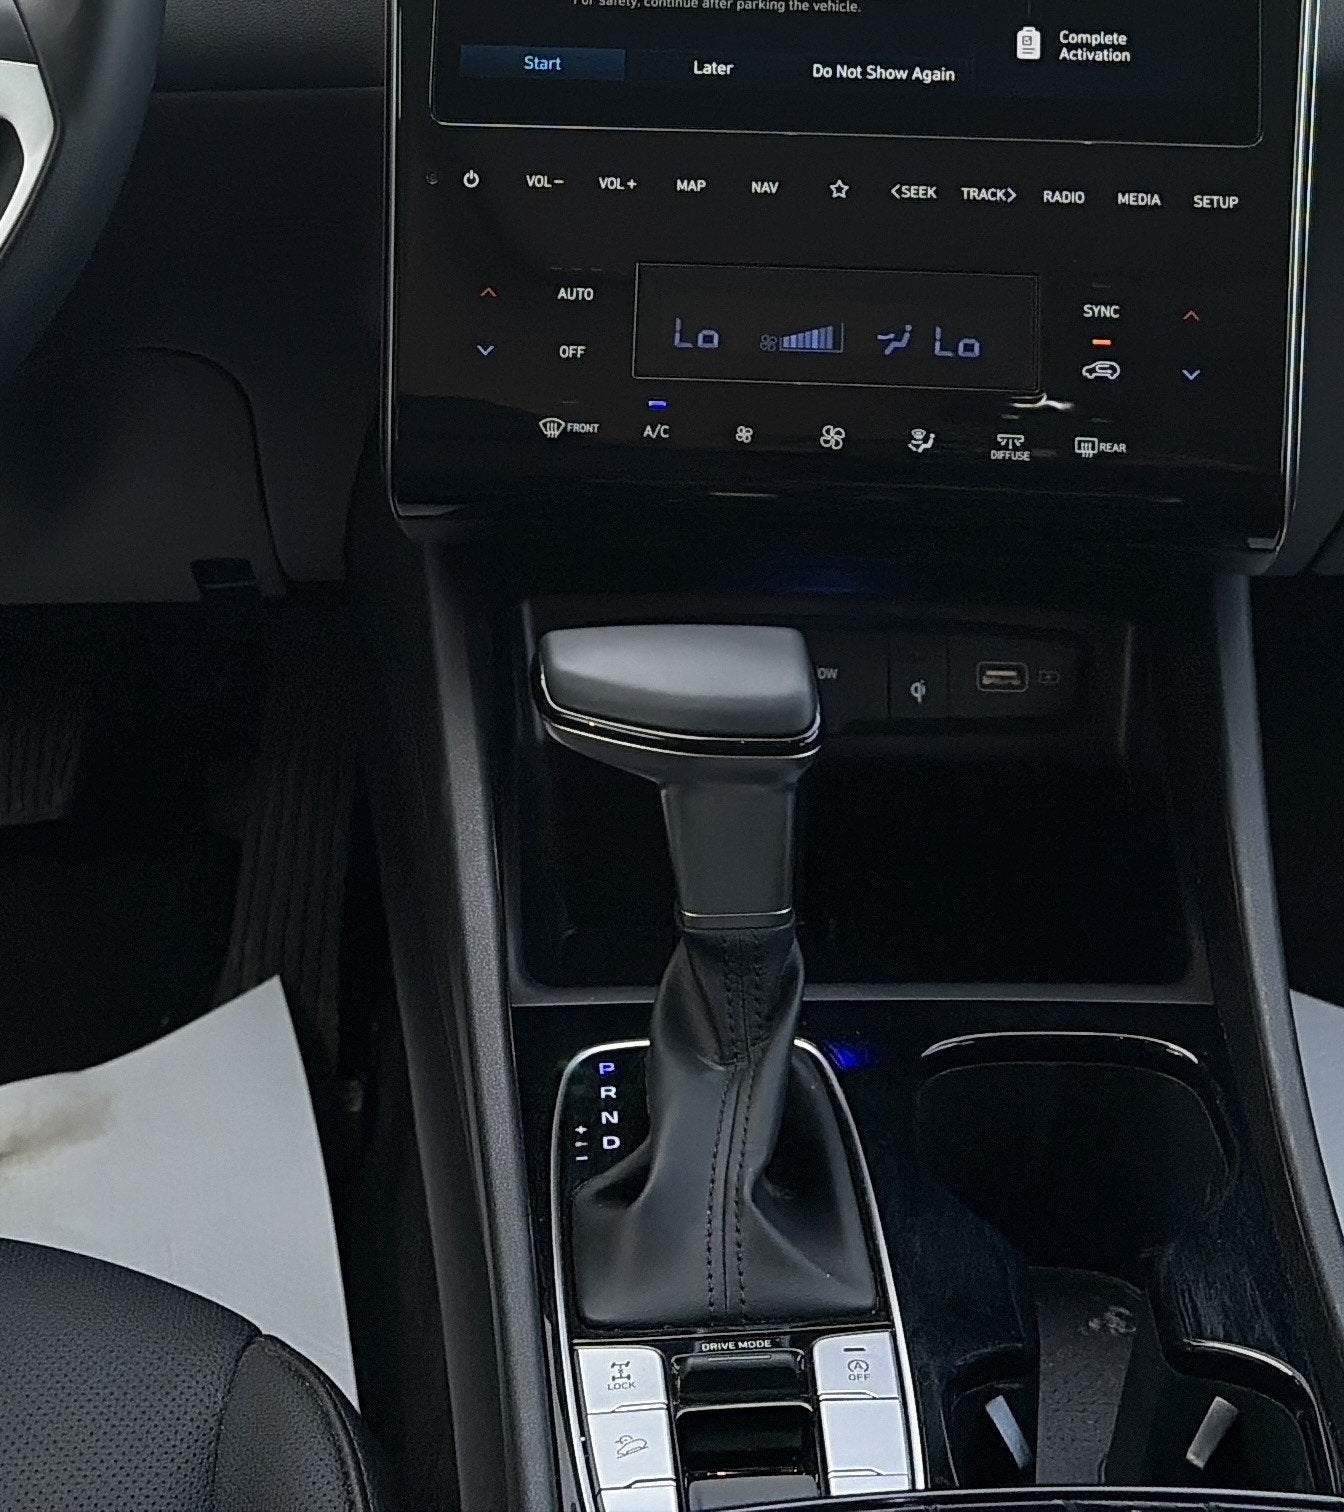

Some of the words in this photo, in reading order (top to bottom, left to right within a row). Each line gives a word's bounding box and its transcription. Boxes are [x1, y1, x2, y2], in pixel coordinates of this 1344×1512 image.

[736, 0, 786, 14] parking
[789, 0, 810, 11] the
[812, 0, 862, 13] vehicle.
[1059, 30, 1128, 47] Complete
[1059, 47, 1131, 62] Activation
[524, 55, 562, 71] Start
[693, 60, 734, 76] Later
[812, 63, 832, 79] Do
[836, 64, 862, 80] Not
[866, 64, 908, 81] Show
[912, 66, 956, 83] Again
[676, 179, 706, 192] MAP
[751, 181, 779, 194] NAV
[1043, 190, 1085, 204] RADIO
[1117, 193, 1162, 206] MEDIA
[1193, 195, 1239, 209] SETUP
[557, 287, 594, 301] AUTO
[1083, 304, 1120, 319] SYNC
[674, 317, 719, 349] Lo
[934, 326, 980, 358] Lo
[559, 345, 586, 359] OFF
[567, 423, 600, 434] FRONT
[643, 424, 670, 438] A/C
[1099, 443, 1127, 453] REAR
[990, 450, 1031, 462] DIFFUSE
[598, 1062, 615, 1075] P
[600, 1086, 617, 1099] R
[601, 1110, 619, 1125] N
[602, 1135, 621, 1150] D
[701, 1341, 735, 1352] DRIVE
[738, 1340, 772, 1350] MODE
[848, 1373, 871, 1381] OFF
[607, 1381, 636, 1391] LOCK
